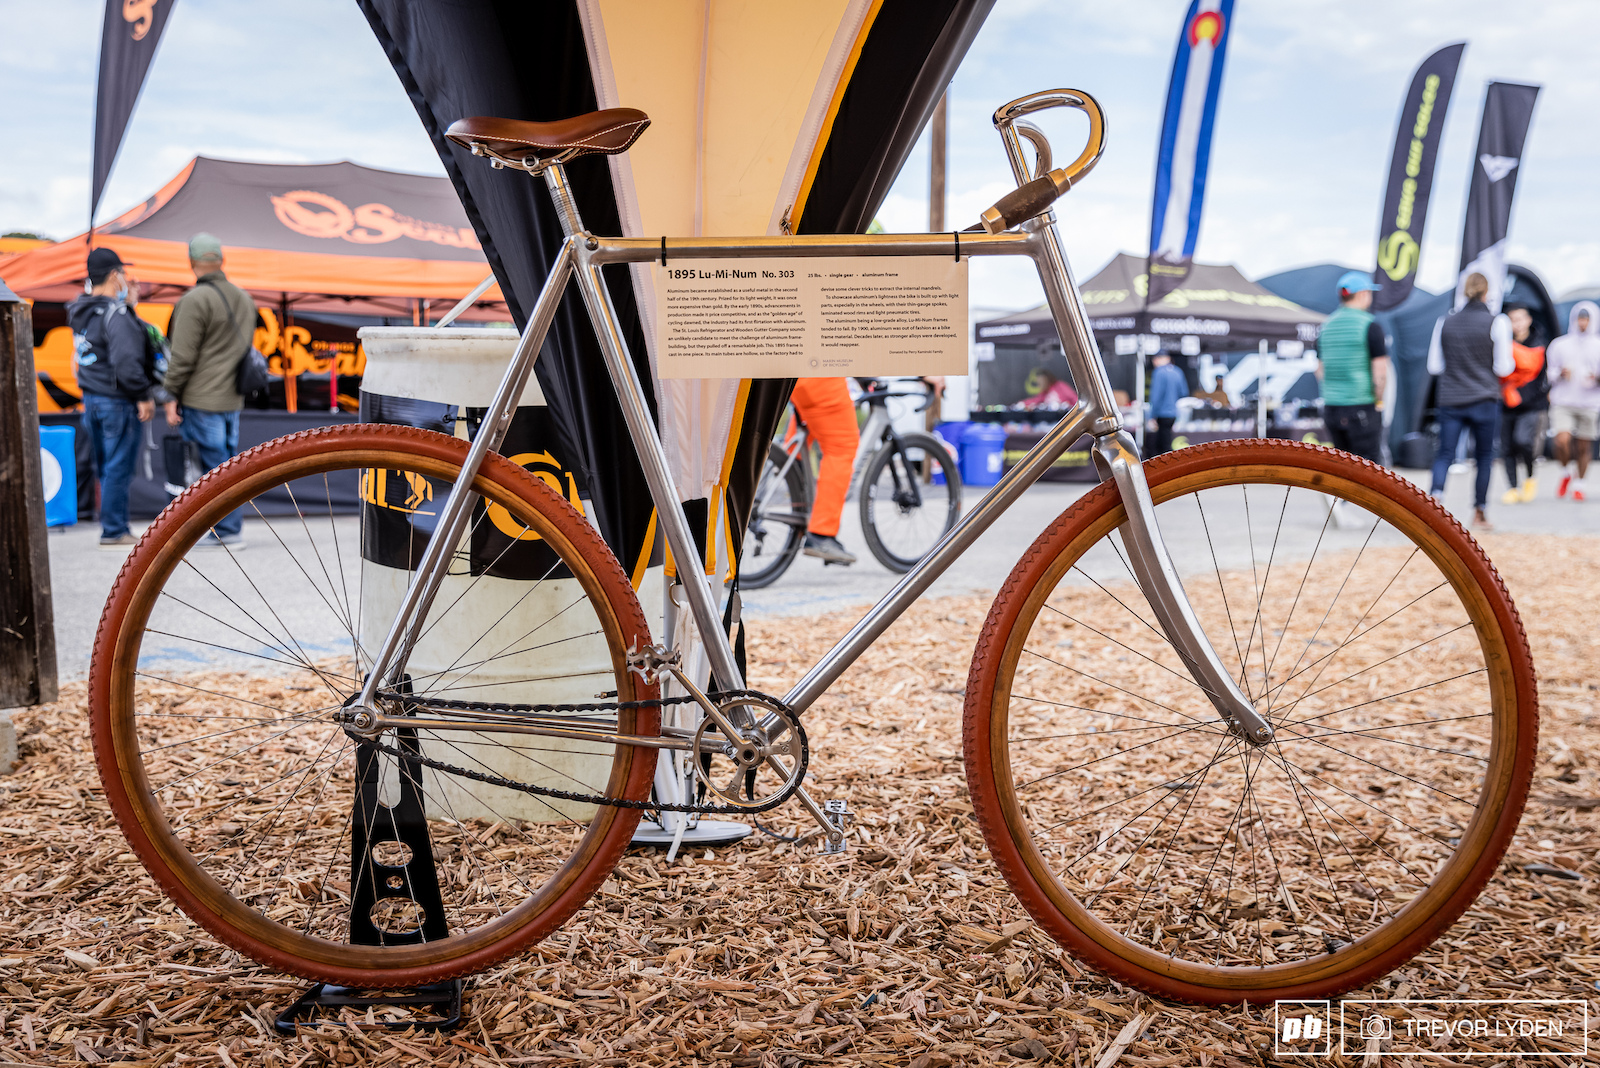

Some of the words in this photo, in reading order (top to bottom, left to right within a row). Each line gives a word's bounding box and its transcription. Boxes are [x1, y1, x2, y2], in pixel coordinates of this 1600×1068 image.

[668, 269, 696, 279] 1895
[699, 269, 757, 279] Lu-Mi-Num
[762, 270, 777, 278] No.
[778, 270, 795, 278] 303
